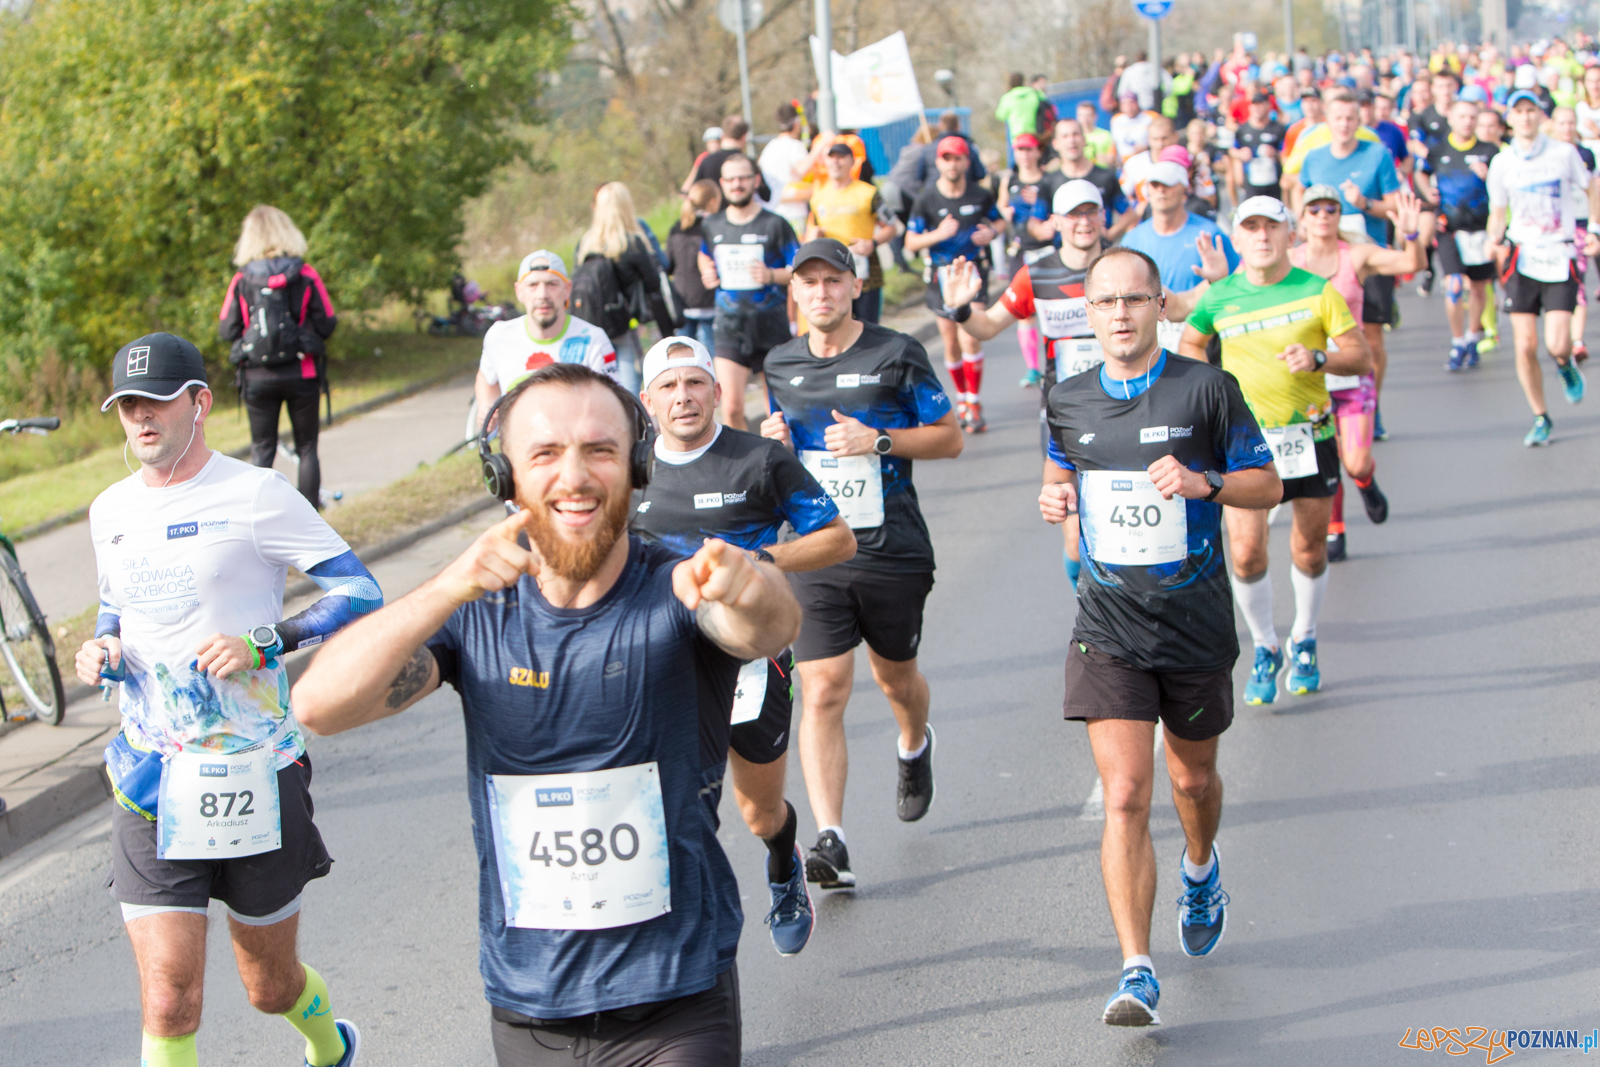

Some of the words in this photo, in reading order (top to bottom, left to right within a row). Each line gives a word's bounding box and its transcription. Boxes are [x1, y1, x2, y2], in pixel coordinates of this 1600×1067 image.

[1078, 433, 1096, 445] 4F
[637, 500, 652, 513] 4F
[1110, 504, 1161, 528] 430
[111, 534, 124, 545] 4F
[122, 557, 150, 570] SIŁA
[130, 564, 194, 584] ODWAGA
[124, 576, 197, 599] SZYBKOŚĆ
[181, 598, 200, 609] 2016
[509, 666, 550, 689] SZALU
[199, 789, 255, 818] 872
[206, 819, 249, 828] Arkadiusz
[529, 822, 640, 868] 4580
[570, 871, 599, 882] Artur
